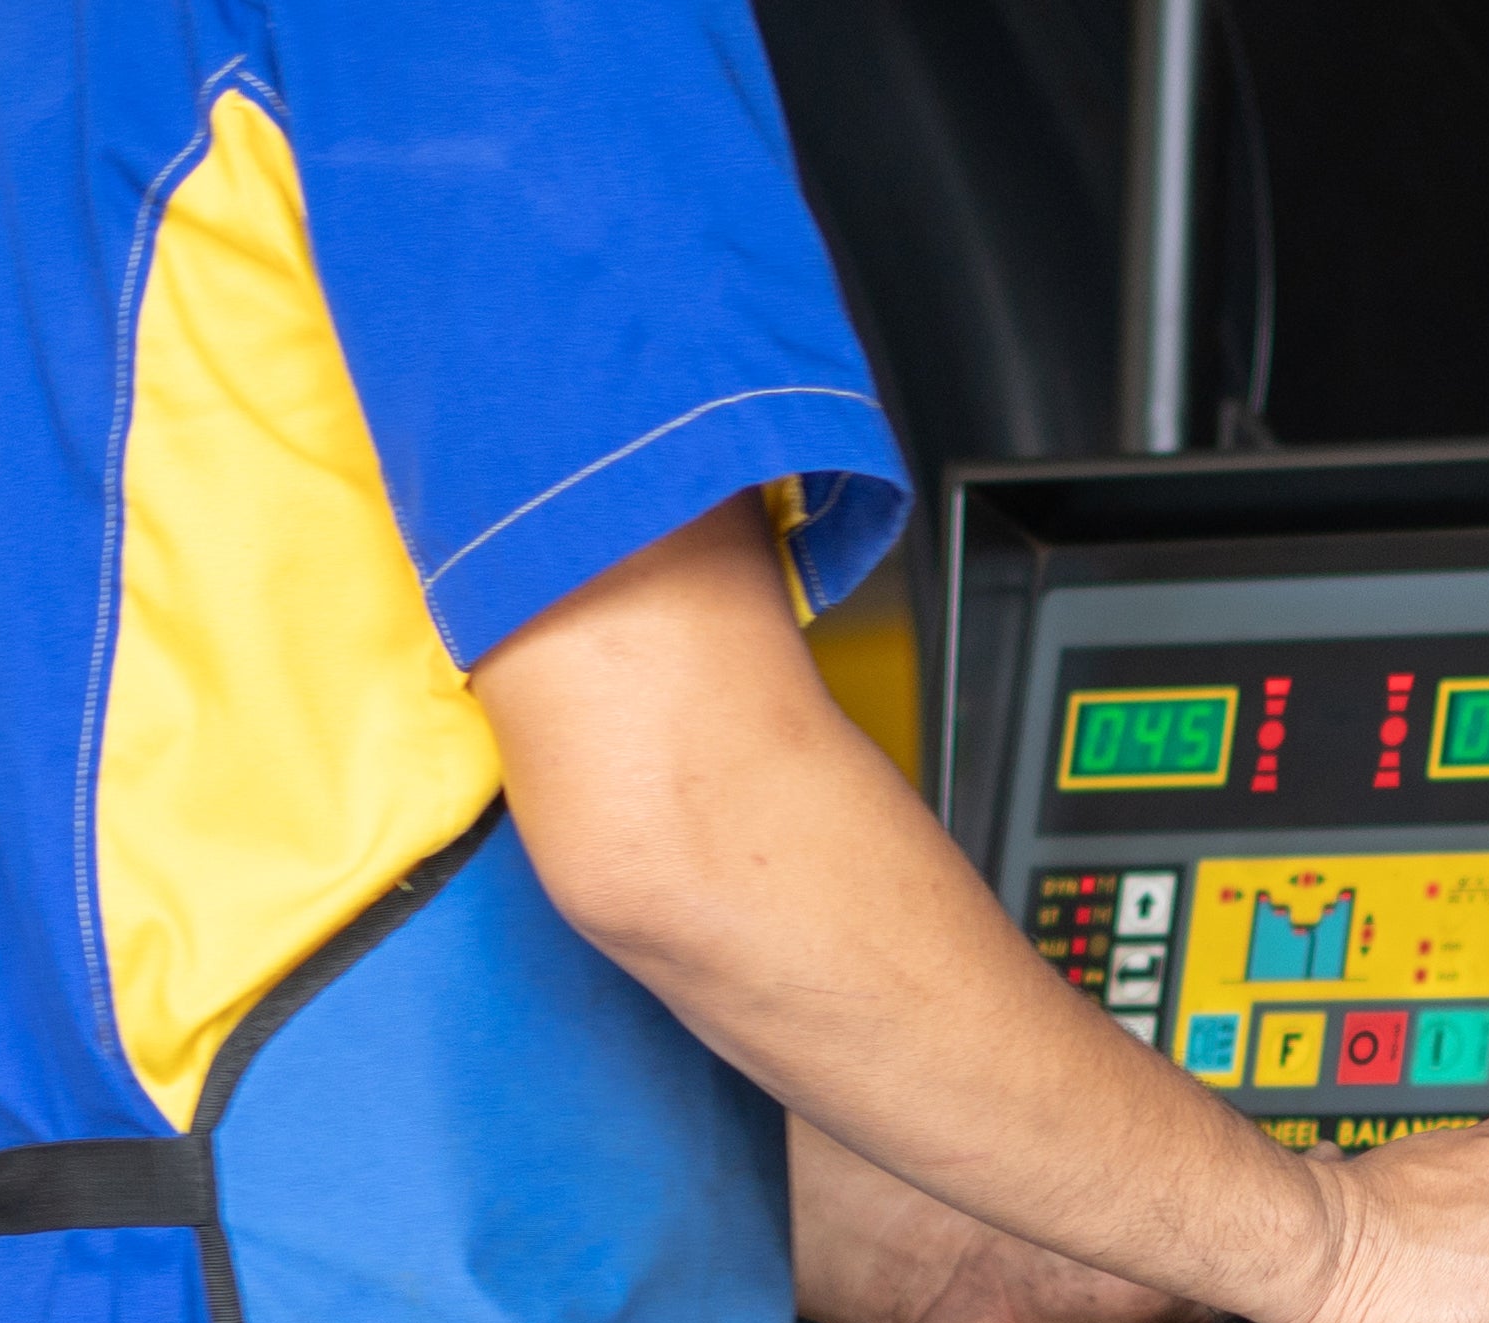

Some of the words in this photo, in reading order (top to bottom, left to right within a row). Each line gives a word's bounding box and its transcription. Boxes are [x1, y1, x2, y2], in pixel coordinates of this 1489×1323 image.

[1081, 703, 1213, 771] 045
[1279, 1032, 1303, 1067] F
[1261, 1119, 1319, 1147] HEEL
